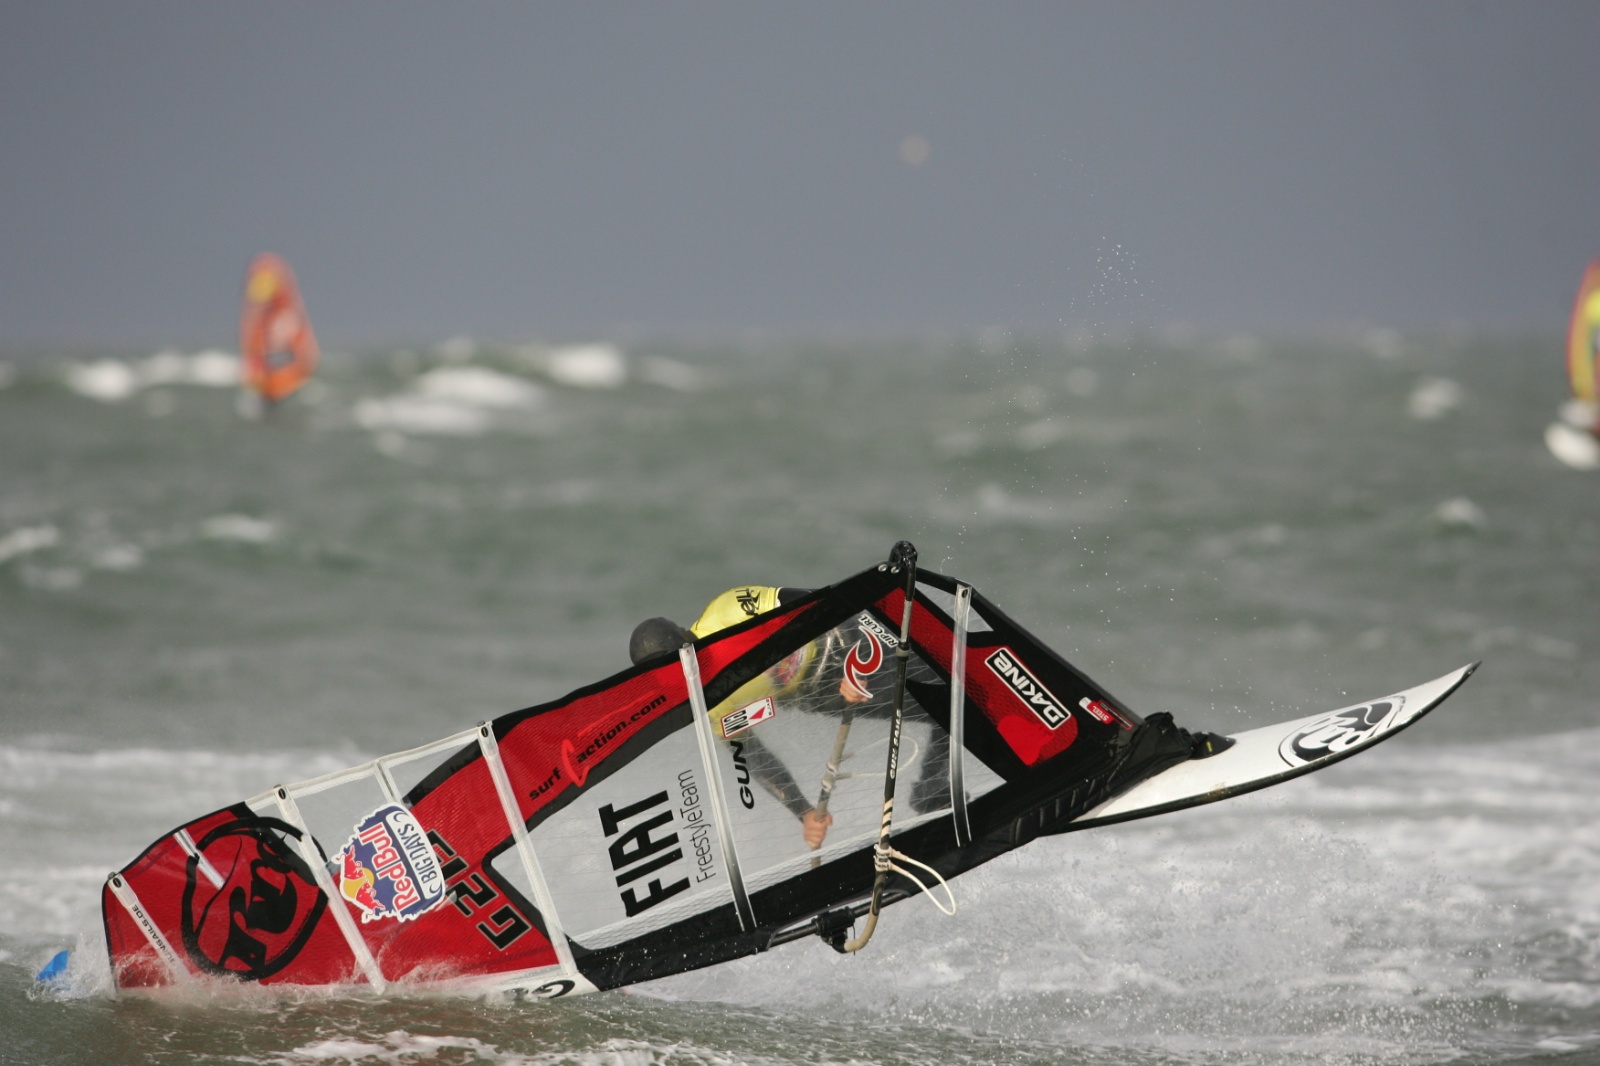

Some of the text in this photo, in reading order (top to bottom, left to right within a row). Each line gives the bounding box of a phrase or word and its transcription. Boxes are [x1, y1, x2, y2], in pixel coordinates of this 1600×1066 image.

[994, 651, 1066, 724] DAKINE
[529, 694, 667, 801] surf action.com
[730, 740, 754, 809] GUN
[598, 790, 690, 918] FIAT
